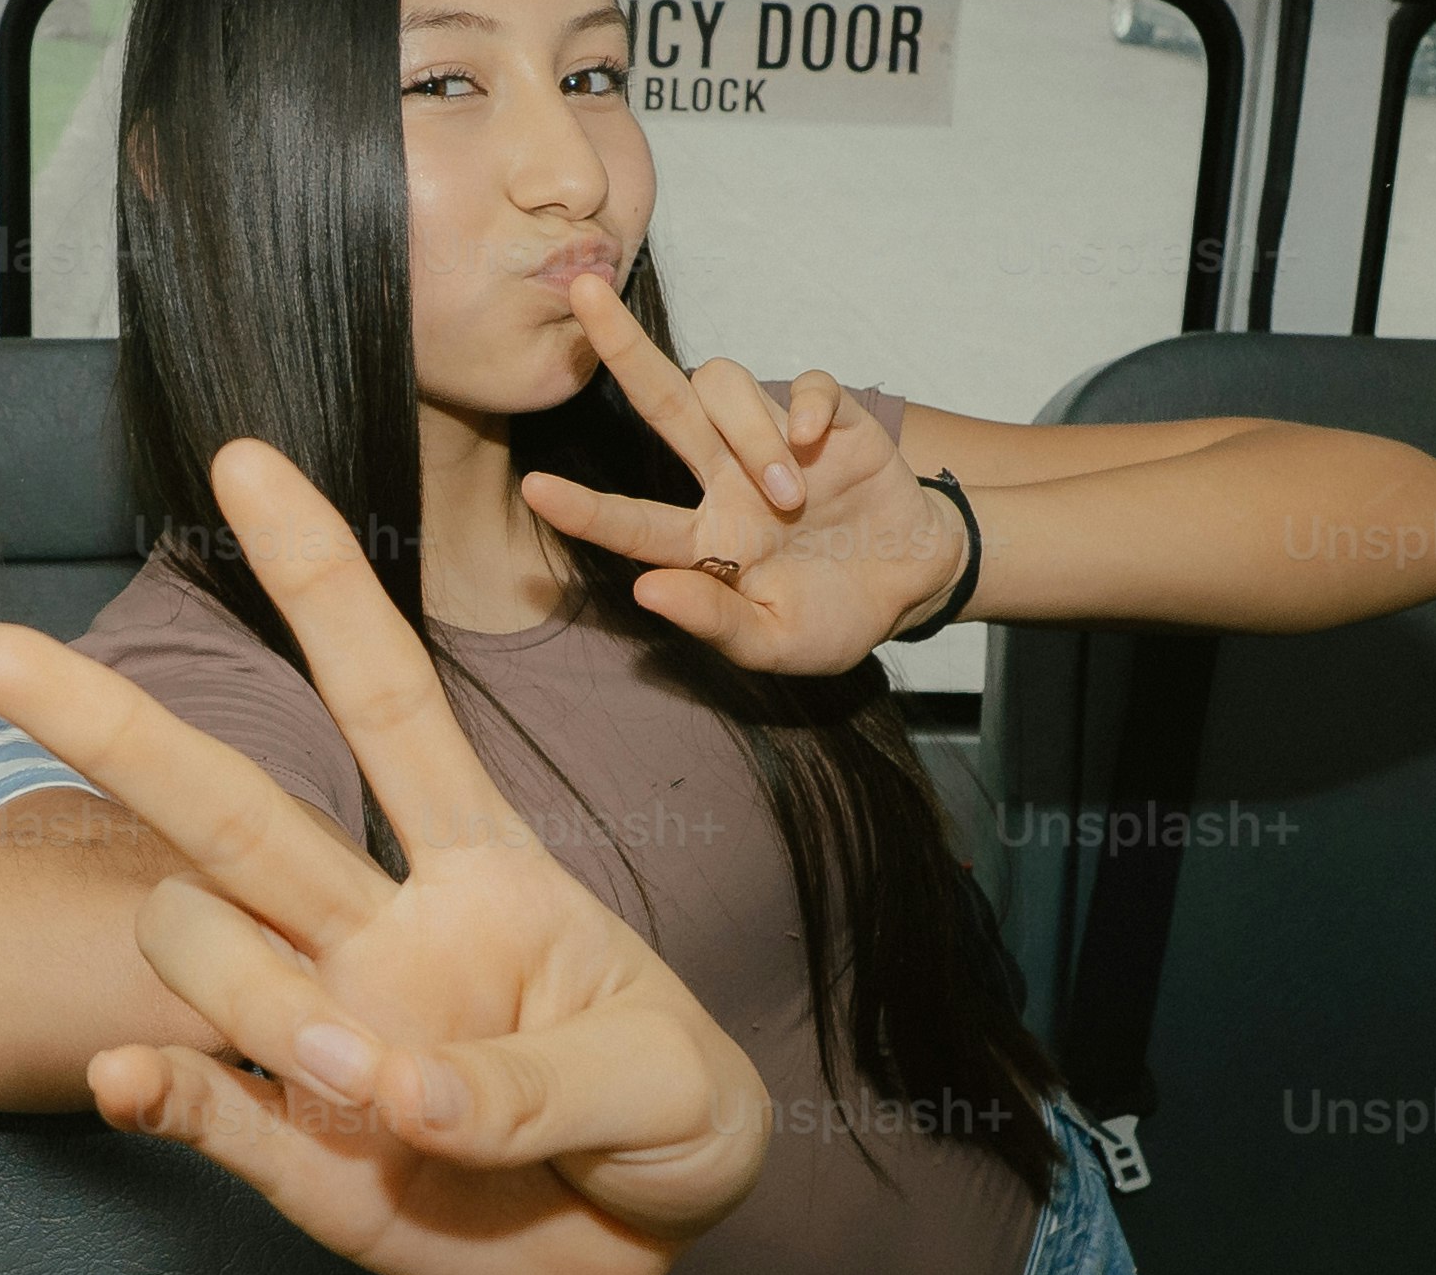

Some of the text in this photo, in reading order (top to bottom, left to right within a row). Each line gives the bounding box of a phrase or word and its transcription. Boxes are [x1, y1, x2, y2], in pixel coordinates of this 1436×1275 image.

[628, 0, 923, 73] CY DOOR
[645, 77, 766, 113] BLOCK
